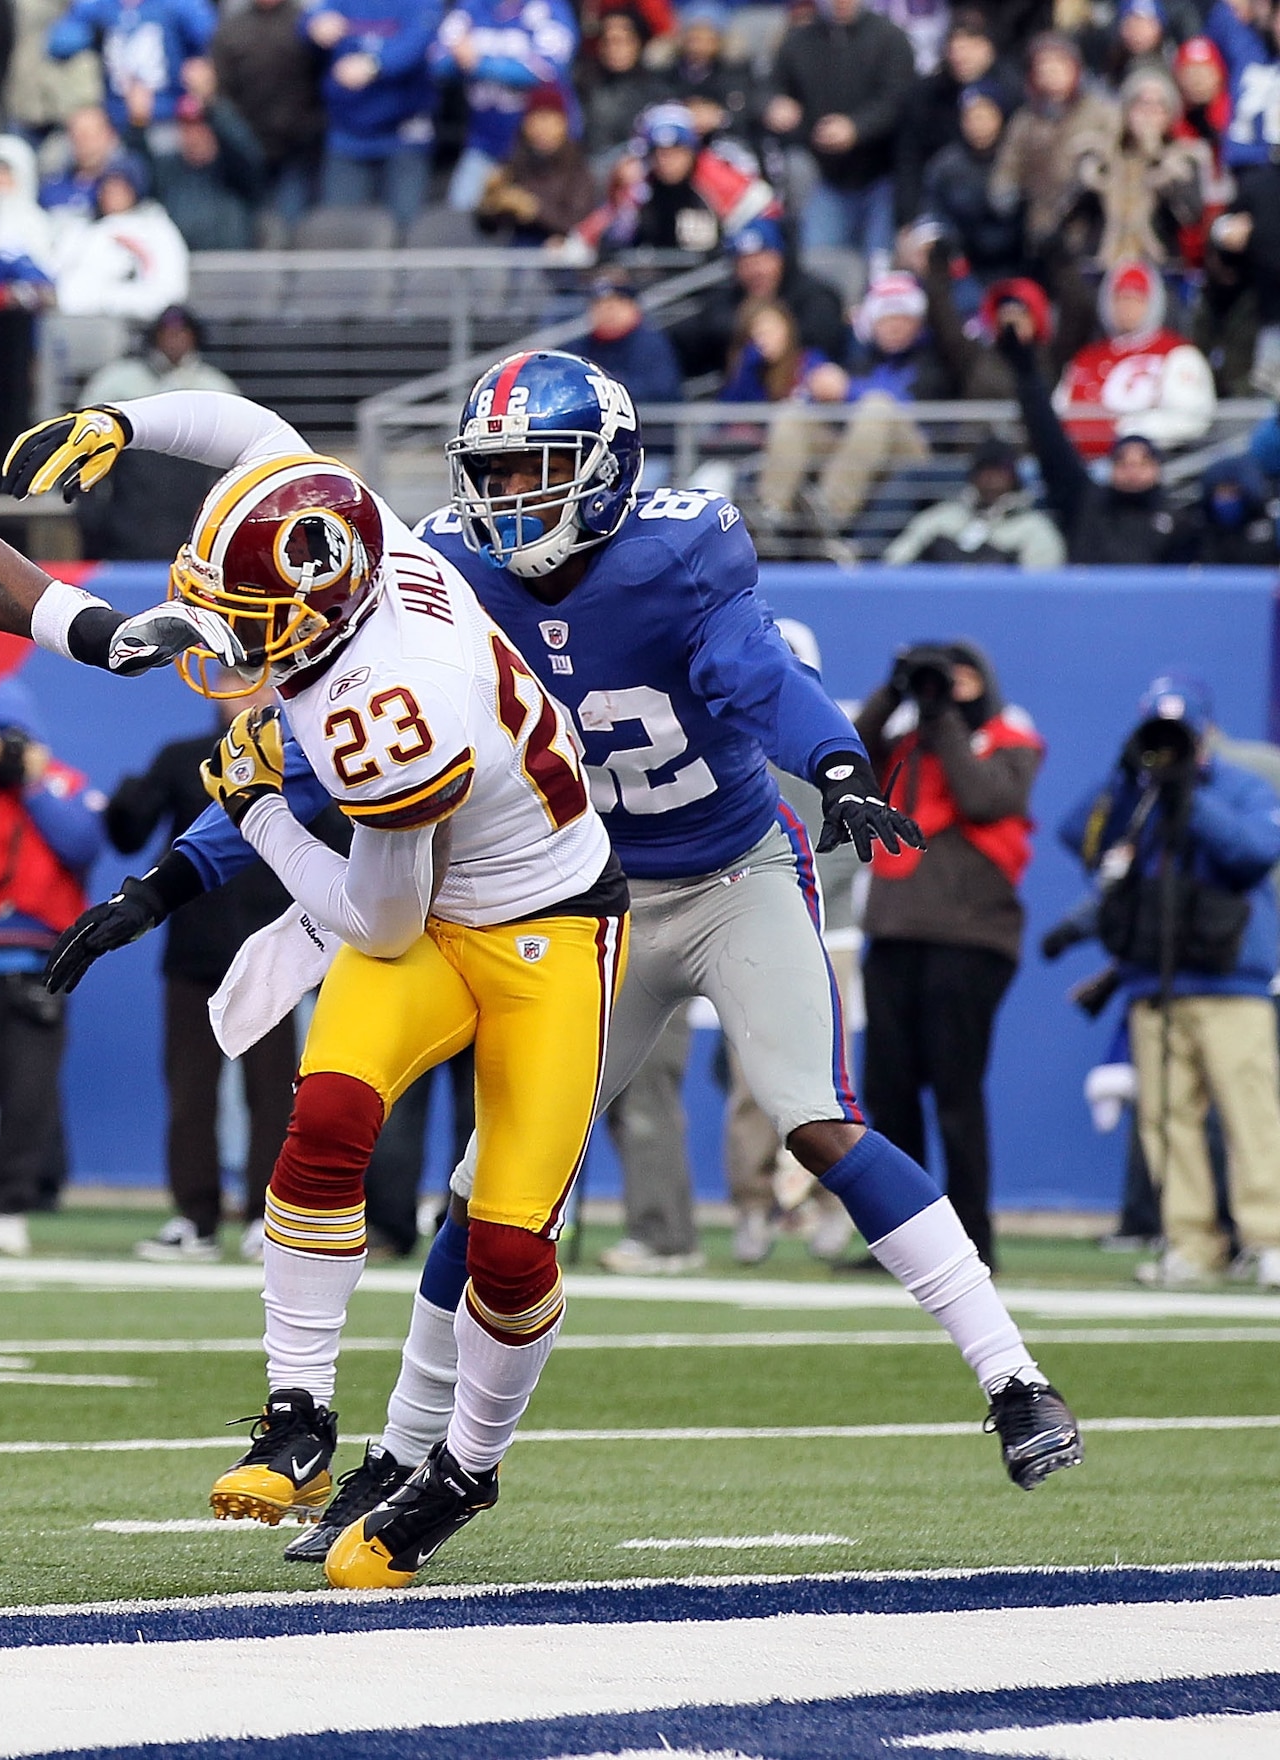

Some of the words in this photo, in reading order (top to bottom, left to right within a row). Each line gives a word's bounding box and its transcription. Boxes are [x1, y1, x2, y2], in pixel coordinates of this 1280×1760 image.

[476, 386, 530, 419] 82
[388, 551, 456, 626] HALL
[324, 684, 436, 790] 23
[300, 912, 325, 953] Wilson
